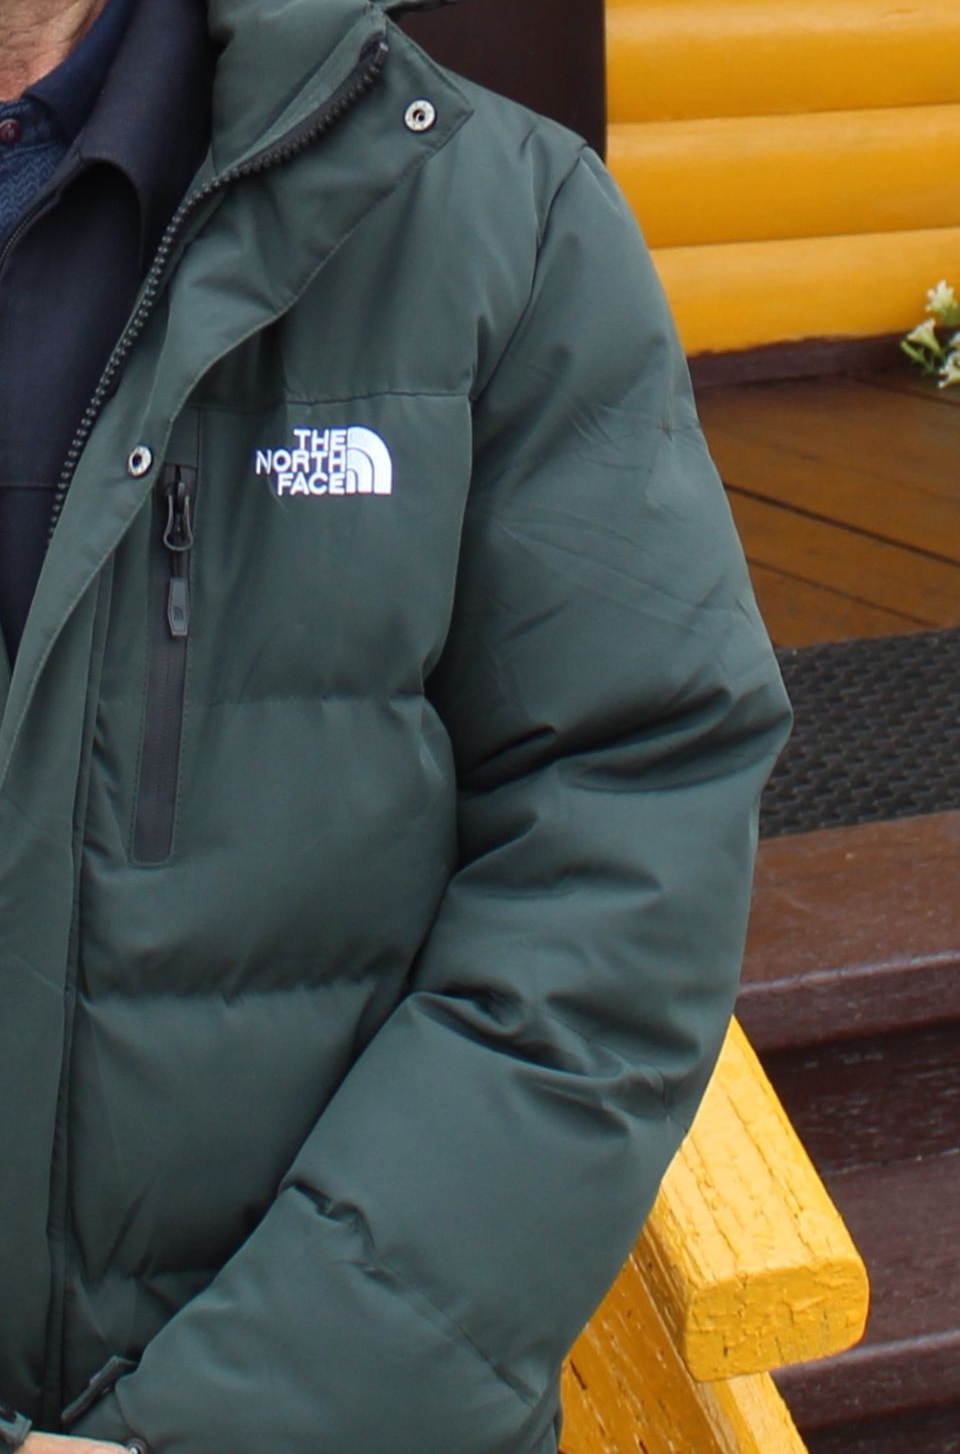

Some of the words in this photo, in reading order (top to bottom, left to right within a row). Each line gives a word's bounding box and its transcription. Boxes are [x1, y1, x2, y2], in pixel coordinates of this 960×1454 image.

[293, 428, 347, 452] THE
[255, 448, 346, 475] NORTH
[277, 471, 347, 496] FACE
